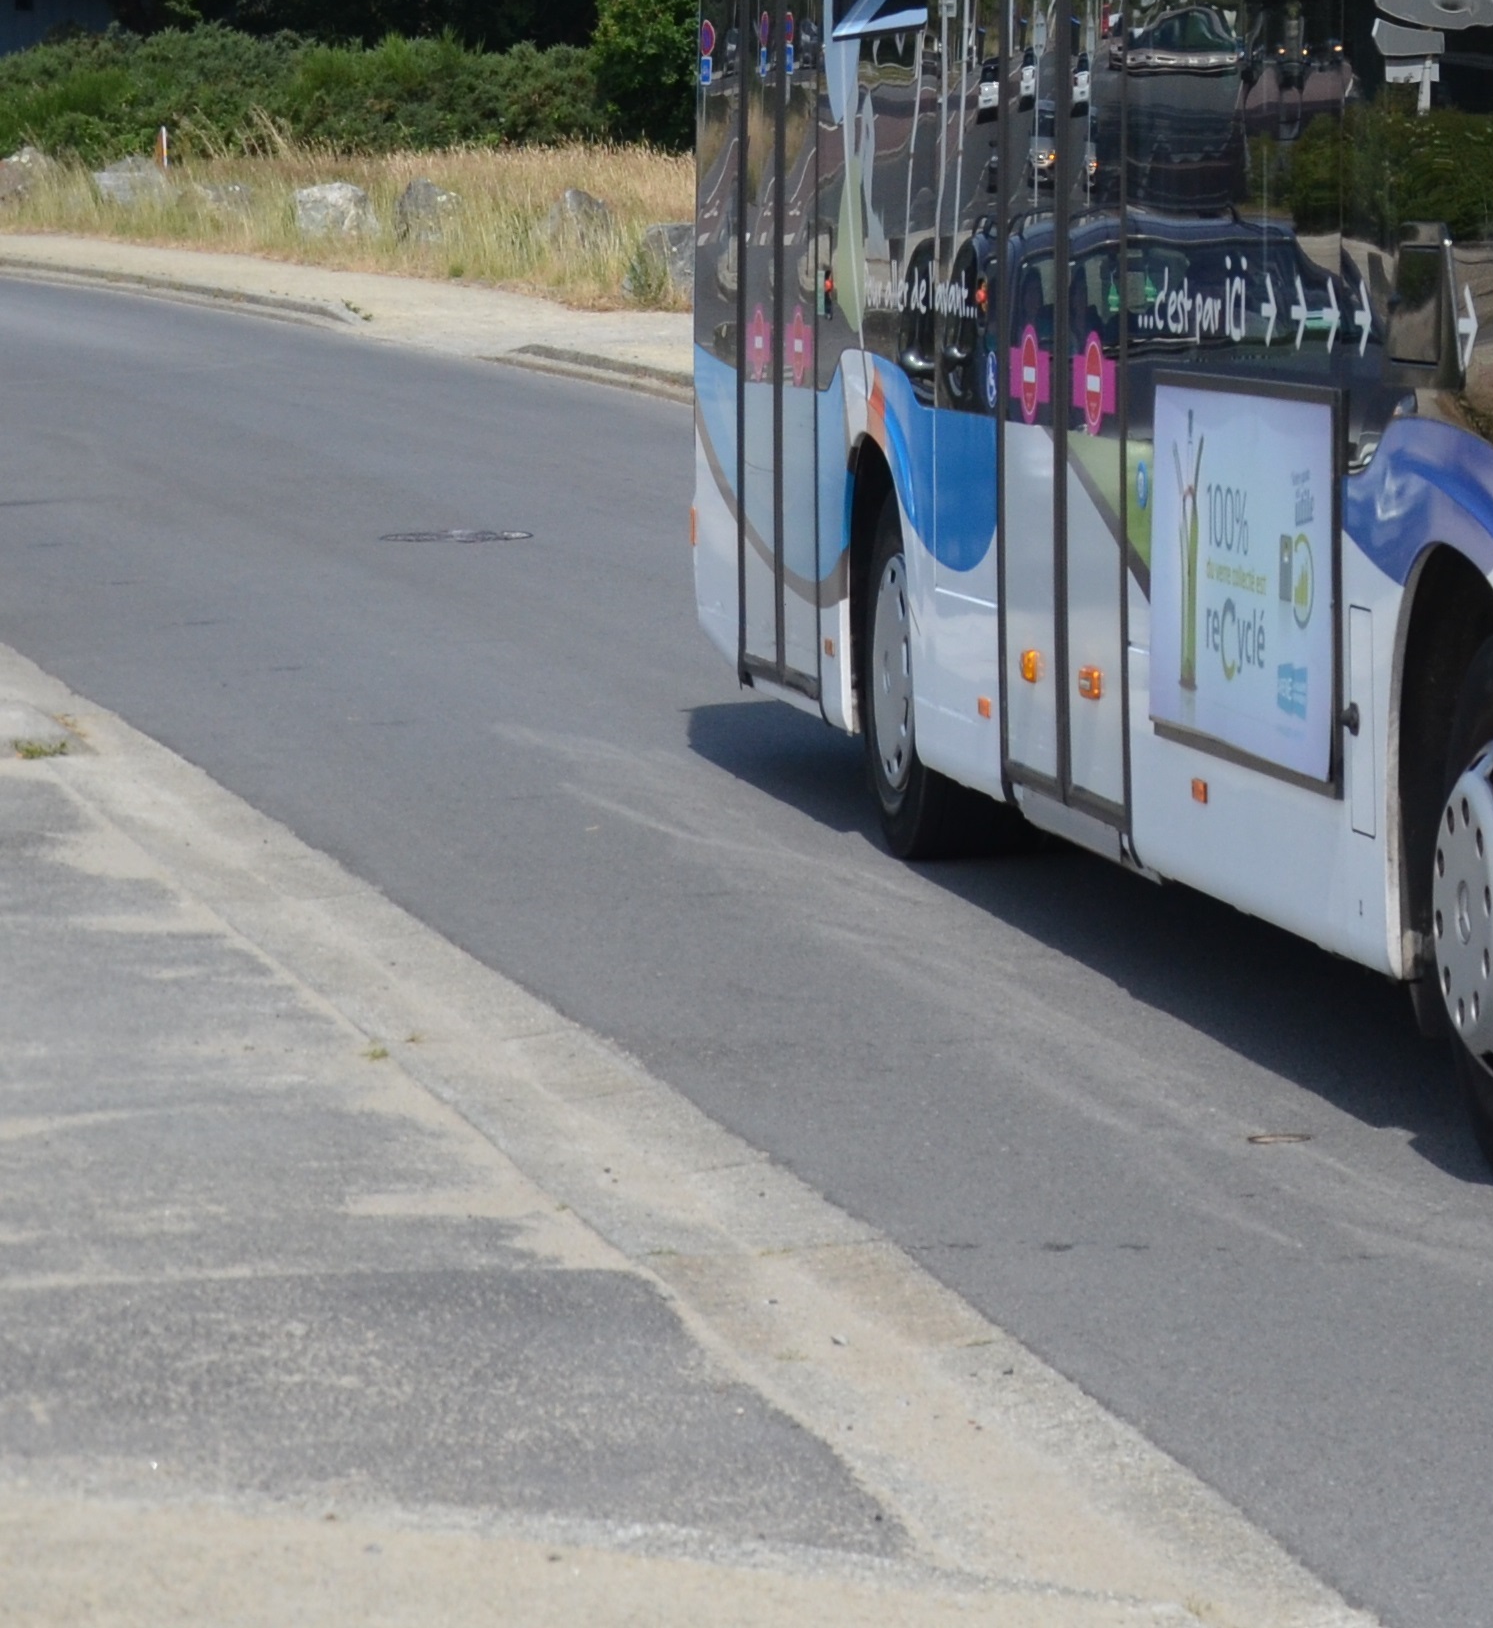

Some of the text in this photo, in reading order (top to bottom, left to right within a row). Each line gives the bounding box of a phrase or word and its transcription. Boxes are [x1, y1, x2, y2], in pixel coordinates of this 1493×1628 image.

[911, 266, 927, 314] de
[1195, 292, 1221, 345] par
[1207, 483, 1249, 556] 100%
